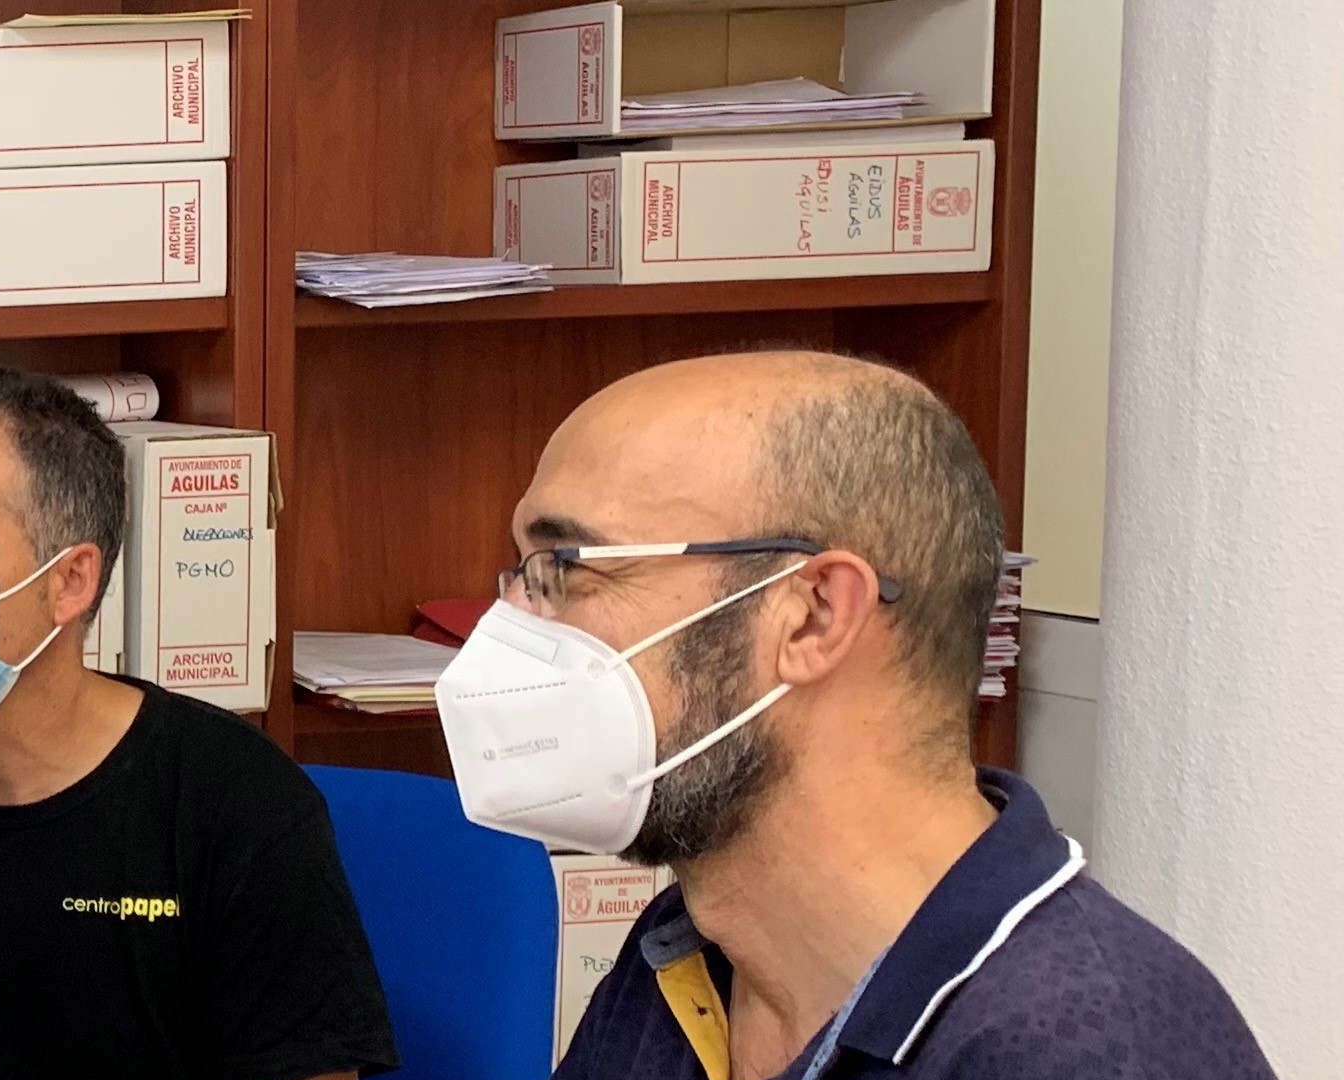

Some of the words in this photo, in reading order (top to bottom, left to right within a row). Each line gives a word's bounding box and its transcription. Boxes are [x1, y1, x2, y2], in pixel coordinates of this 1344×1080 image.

[172, 64, 185, 119] ARCHIVO
[187, 57, 200, 125] MUNICIPAL
[897, 176, 914, 232] ÁGUILAS
[913, 159, 925, 232] AYUNTAMIENTO
[646, 179, 660, 246] MUNICIPAL
[660, 183, 675, 239] ARCHIVO
[168, 205, 181, 260] ARCHIVO
[183, 198, 197, 266] MUNICIPAL
[913, 234, 922, 247] DE
[168, 460, 230, 472] AYUNTAMIENTO
[230, 459, 243, 470] DE
[171, 473, 240, 492] AGUILAS
[184, 503, 214, 515] CAJA
[175, 558, 235, 580] PGMO
[171, 652, 233, 667] ARCHIVO
[165, 666, 239, 682] MUNICIPAL
[593, 875, 653, 886] AYUNTAMIENTO
[617, 887, 628, 897] DE
[596, 898, 648, 915] ÁGUILAS
